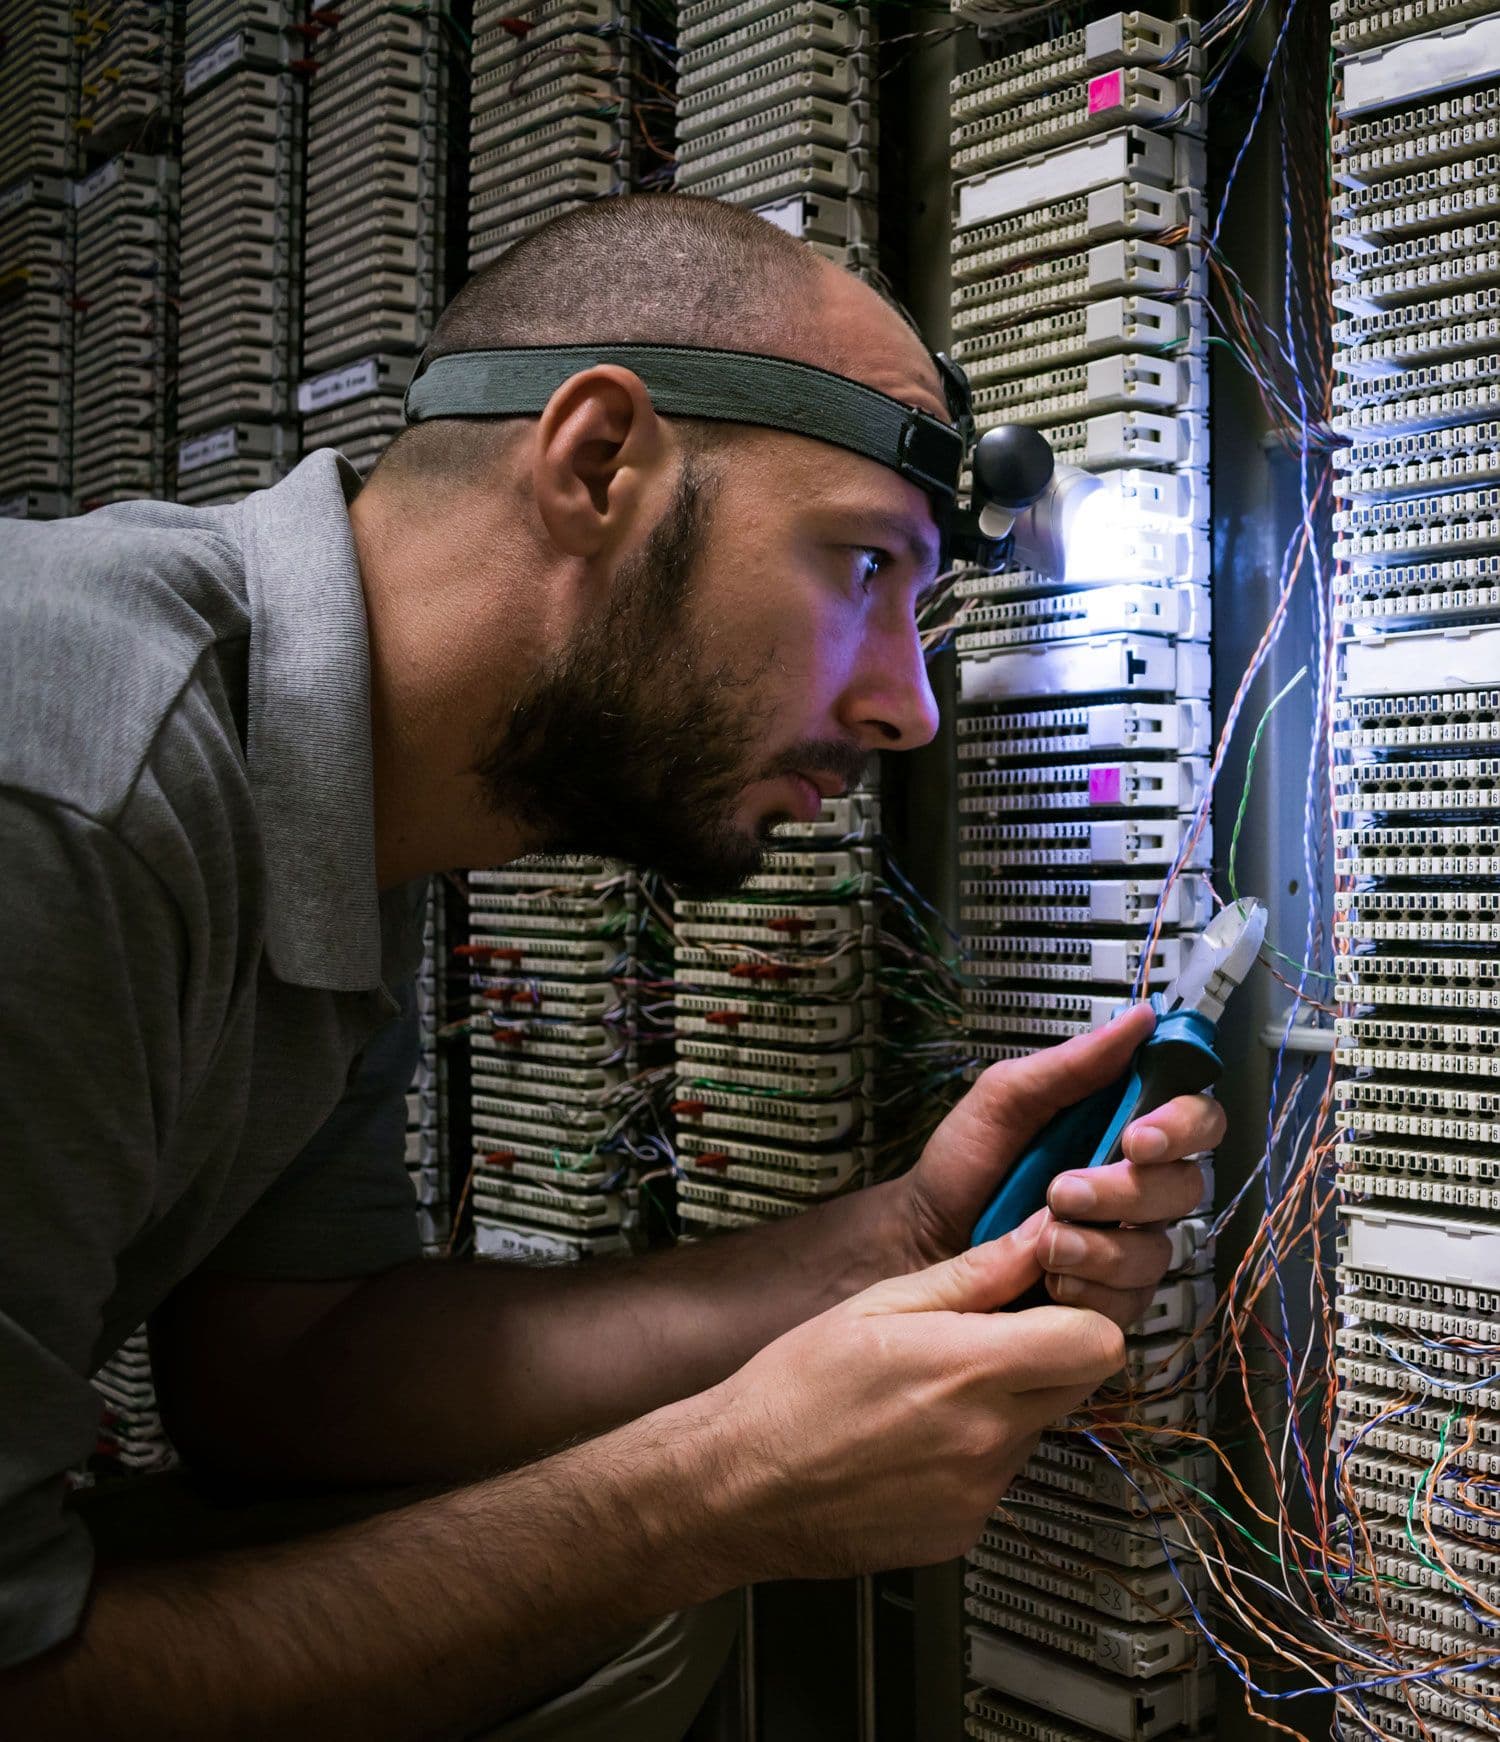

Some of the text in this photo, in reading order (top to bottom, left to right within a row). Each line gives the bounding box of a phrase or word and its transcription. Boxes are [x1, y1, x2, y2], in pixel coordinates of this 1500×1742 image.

[1333, 6, 1339, 16] 7
[1350, 25, 1355, 35] 0
[1394, 11, 1399, 22] 2
[1417, 4, 1422, 15] 3
[1334, 140, 1339, 150] 0
[1351, 159, 1356, 168] 0
[1395, 147, 1400, 157] 2
[1418, 141, 1423, 151] 3
[1440, 134, 1446, 144] 4
[1464, 128, 1470, 139] 5
[1488, 122, 1494, 133] 6
[1351, 221, 1357, 231] 0
[1396, 210, 1400, 221] 2
[1418, 205, 1424, 215] 3
[1441, 199, 1446, 208] 4
[1465, 193, 1470, 204] 5
[1488, 188, 1494, 198] 6
[1335, 265, 1340, 275] 2
[1351, 285, 1357, 296] 0
[1396, 276, 1400, 286] 2
[1419, 270, 1424, 281] 3
[1442, 265, 1446, 274] 4
[1466, 260, 1471, 270] 5
[1490, 255, 1495, 265] 6
[1335, 328, 1341, 338] 3
[1352, 350, 1357, 360] 0
[1396, 341, 1401, 351] 2
[1420, 336, 1424, 346] 3
[1442, 331, 1447, 341] 4
[1466, 327, 1472, 337] 5
[1490, 322, 1495, 333] 6
[1336, 391, 1341, 400] 4
[1397, 388, 1496, 416] 2 3 4 5 6
[1443, 463, 1448, 473] 4
[1467, 460, 1473, 470] 5
[1491, 456, 1496, 466] 6
[1444, 524, 1497, 539] 4 5 6
[1444, 590, 1497, 605] 4 5 6
[1336, 709, 1342, 719] 0
[1444, 726, 1498, 738] 4 5 6
[1398, 793, 1498, 806] 2 3 4 5 6
[1336, 835, 1342, 845] 2
[1354, 862, 1360, 872] 0
[1398, 861, 1403, 871] 2
[1422, 861, 1426, 872] 3
[1445, 861, 1449, 870] 4
[1468, 861, 1474, 871] 5
[1492, 861, 1498, 871] 6
[1337, 899, 1343, 909] 3
[1398, 926, 1404, 936] 2
[1422, 926, 1427, 937] 3
[1444, 927, 1450, 936] 4
[1469, 927, 1474, 938] 5
[1492, 928, 1498, 938] 6
[1338, 962, 1343, 972] 4
[1354, 989, 1360, 999] 0
[1398, 991, 1404, 1001] 2
[1422, 992, 1427, 1003] 3
[1445, 993, 1450, 1002] 4
[1469, 994, 1474, 1005] 5
[1493, 995, 1498, 1006] 6
[1337, 1025, 1342, 1035] 5
[1354, 1053, 1360, 1063] 0
[1398, 1056, 1404, 1066] 2
[1422, 1057, 1427, 1068] 3
[1444, 1059, 1450, 1069] 4
[1469, 1061, 1474, 1071] 5
[1492, 1063, 1498, 1073] 6
[1337, 1088, 1342, 1098] 6
[1354, 1116, 1360, 1126] 0
[1399, 1120, 1404, 1130] 2
[1422, 1122, 1427, 1133] 3
[1444, 1124, 1450, 1134] 4
[1469, 1127, 1474, 1137] 5
[1493, 1129, 1498, 1140] 6
[1338, 1151, 1343, 1161] 7
[1355, 1179, 1360, 1189] 0
[1399, 1184, 1404, 1194] 2
[1422, 1187, 1427, 1197] 3
[1445, 1190, 1450, 1200] 4
[1469, 1193, 1474, 1204] 5
[1493, 1196, 1498, 1206] 6
[1354, 1304, 1360, 1314] 0
[1398, 1312, 1404, 1323] 2
[1421, 1316, 1426, 1327] 3
[1444, 1320, 1449, 1331] 4
[1468, 1325, 1473, 1336] 5
[1491, 1329, 1497, 1340] 6
[1354, 1367, 1360, 1377] 0
[1398, 1376, 1404, 1387] 2
[1420, 1382, 1426, 1393] 3
[1467, 1391, 1472, 1402] 5
[1490, 1396, 1496, 1407] 6
[1398, 1440, 1404, 1451] 2
[1421, 1445, 1427, 1456] 3
[1468, 1455, 1473, 1466] 5
[1490, 1461, 1496, 1472] 6
[1355, 1491, 1360, 1502] 0
[1399, 1503, 1404, 1514] 2
[1444, 1514, 1449, 1525] 4
[1467, 1520, 1473, 1531] 5
[1491, 1526, 1496, 1536] 6
[1398, 1566, 1404, 1577] 2
[1421, 1573, 1426, 1583] 3
[1490, 1592, 1496, 1603] 6
[1099, 1584, 1122, 1610] 28
[1398, 1629, 1403, 1639] 2
[1420, 1635, 1426, 1646] 3
[1442, 1642, 1448, 1653] 4
[1100, 1635, 1124, 1671] 32
[1419, 1696, 1447, 1713] 3 4
